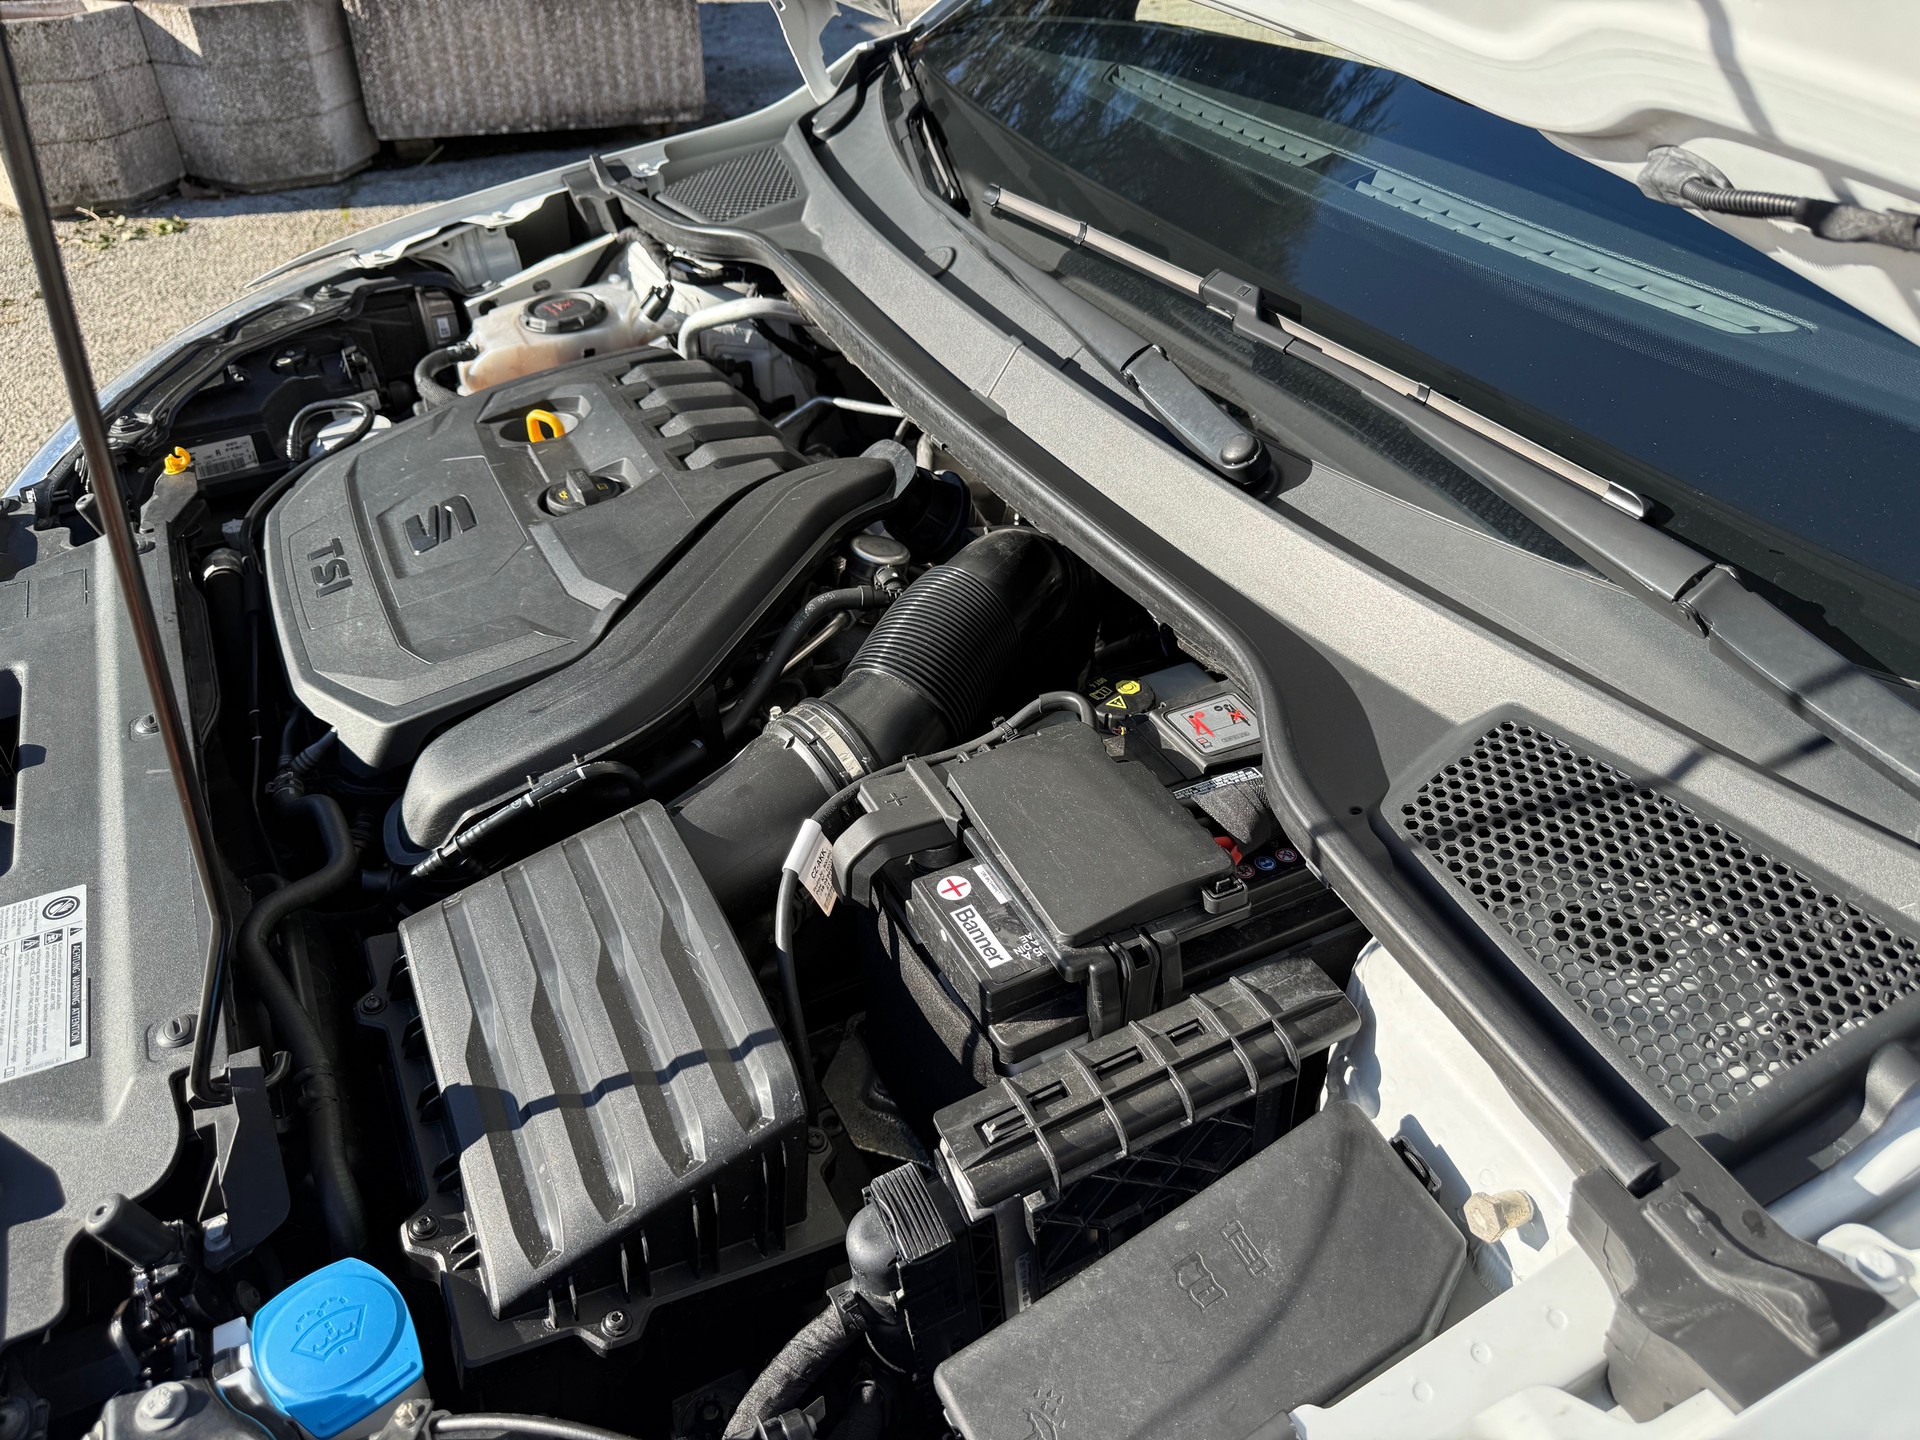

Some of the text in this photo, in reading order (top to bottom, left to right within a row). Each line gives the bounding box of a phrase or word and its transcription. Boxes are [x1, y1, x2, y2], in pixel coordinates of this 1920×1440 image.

[308, 536, 353, 599] TSI
[955, 907, 1004, 962] Banner
[1013, 943, 1032, 955] DIN
[71, 944, 81, 1043] ACHTUNG WARNING ATTENTION
